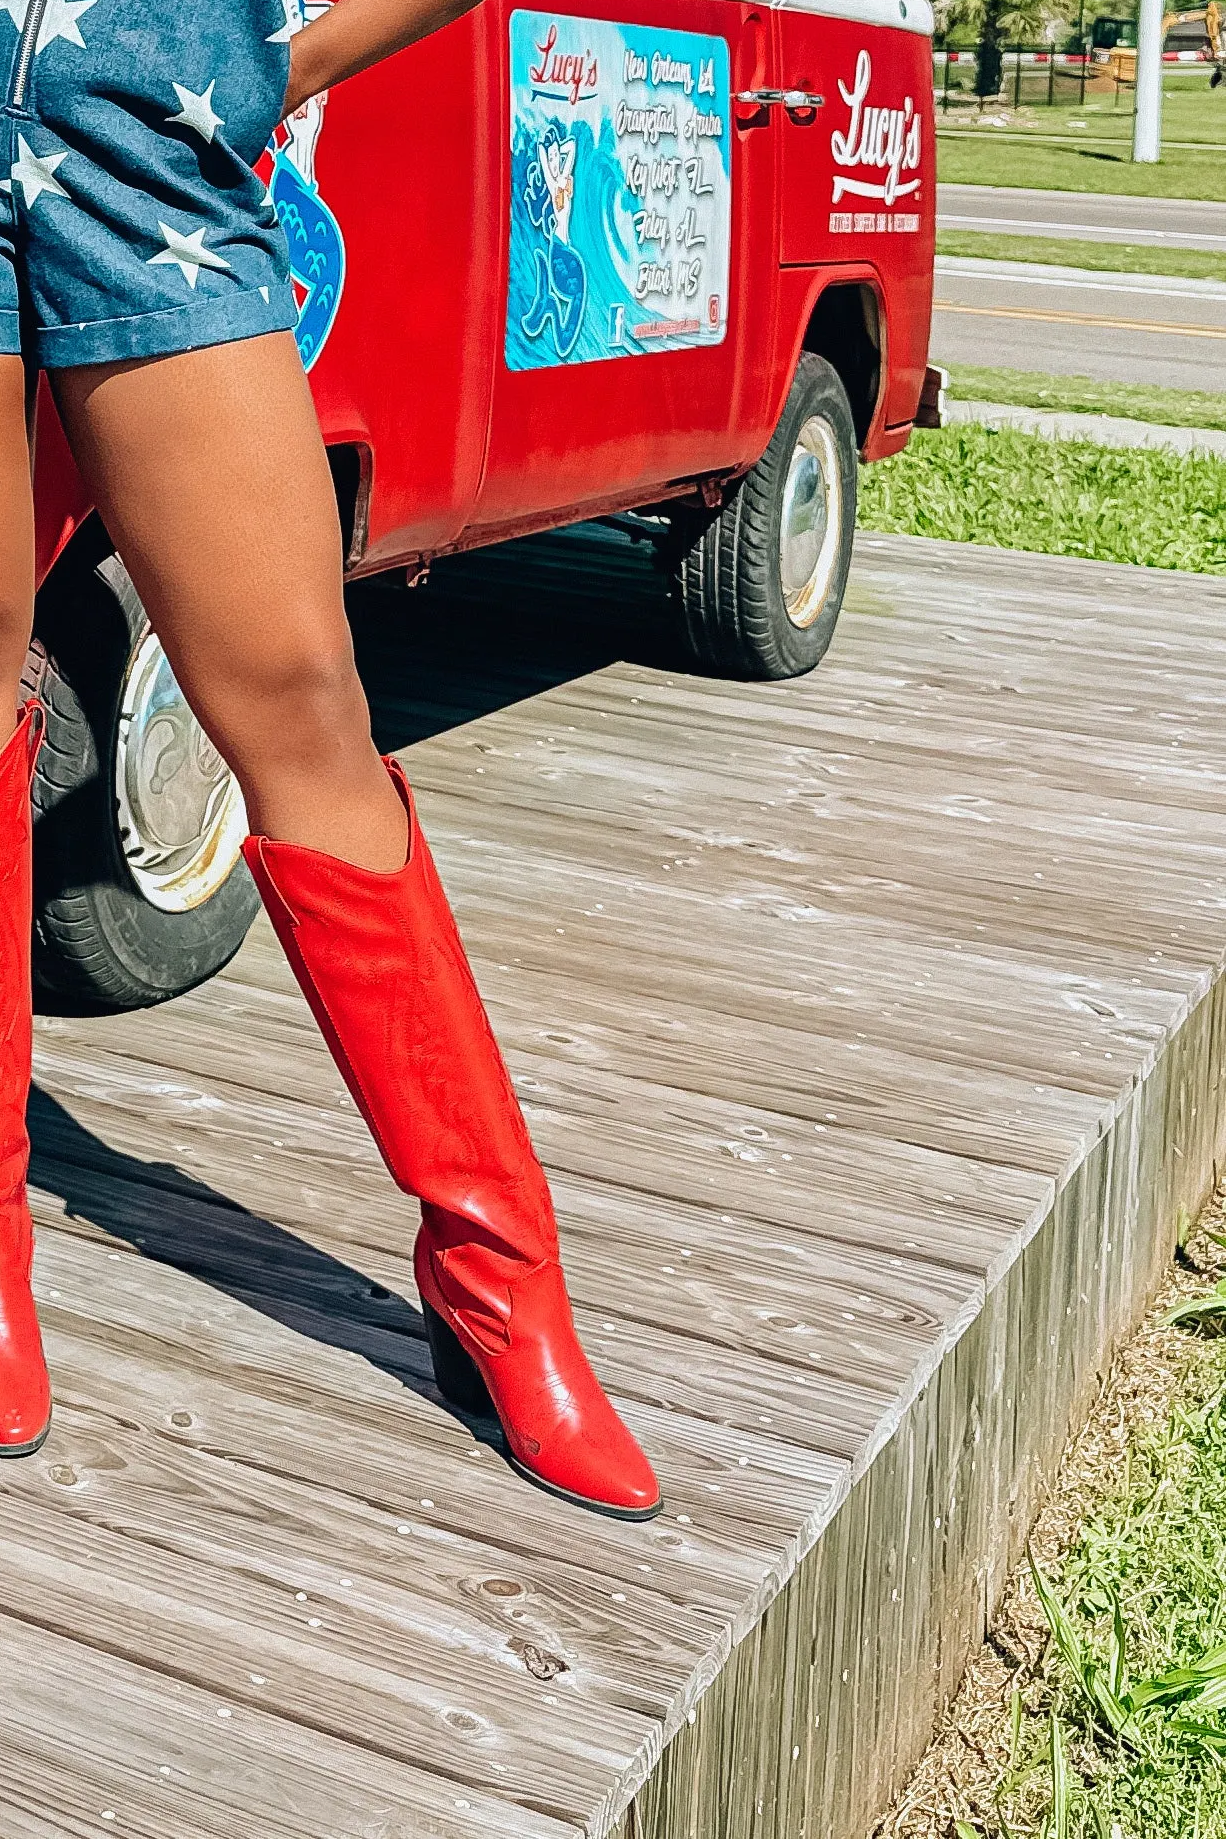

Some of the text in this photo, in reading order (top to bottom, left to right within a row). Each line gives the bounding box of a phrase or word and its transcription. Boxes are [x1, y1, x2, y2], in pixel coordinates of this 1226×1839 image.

[530, 23, 598, 105] Lucy's
[623, 48, 648, 82] New
[831, 49, 921, 206] Lucy's
[626, 154, 649, 198] Key
[685, 157, 714, 195] FL
[675, 257, 702, 296] MS
